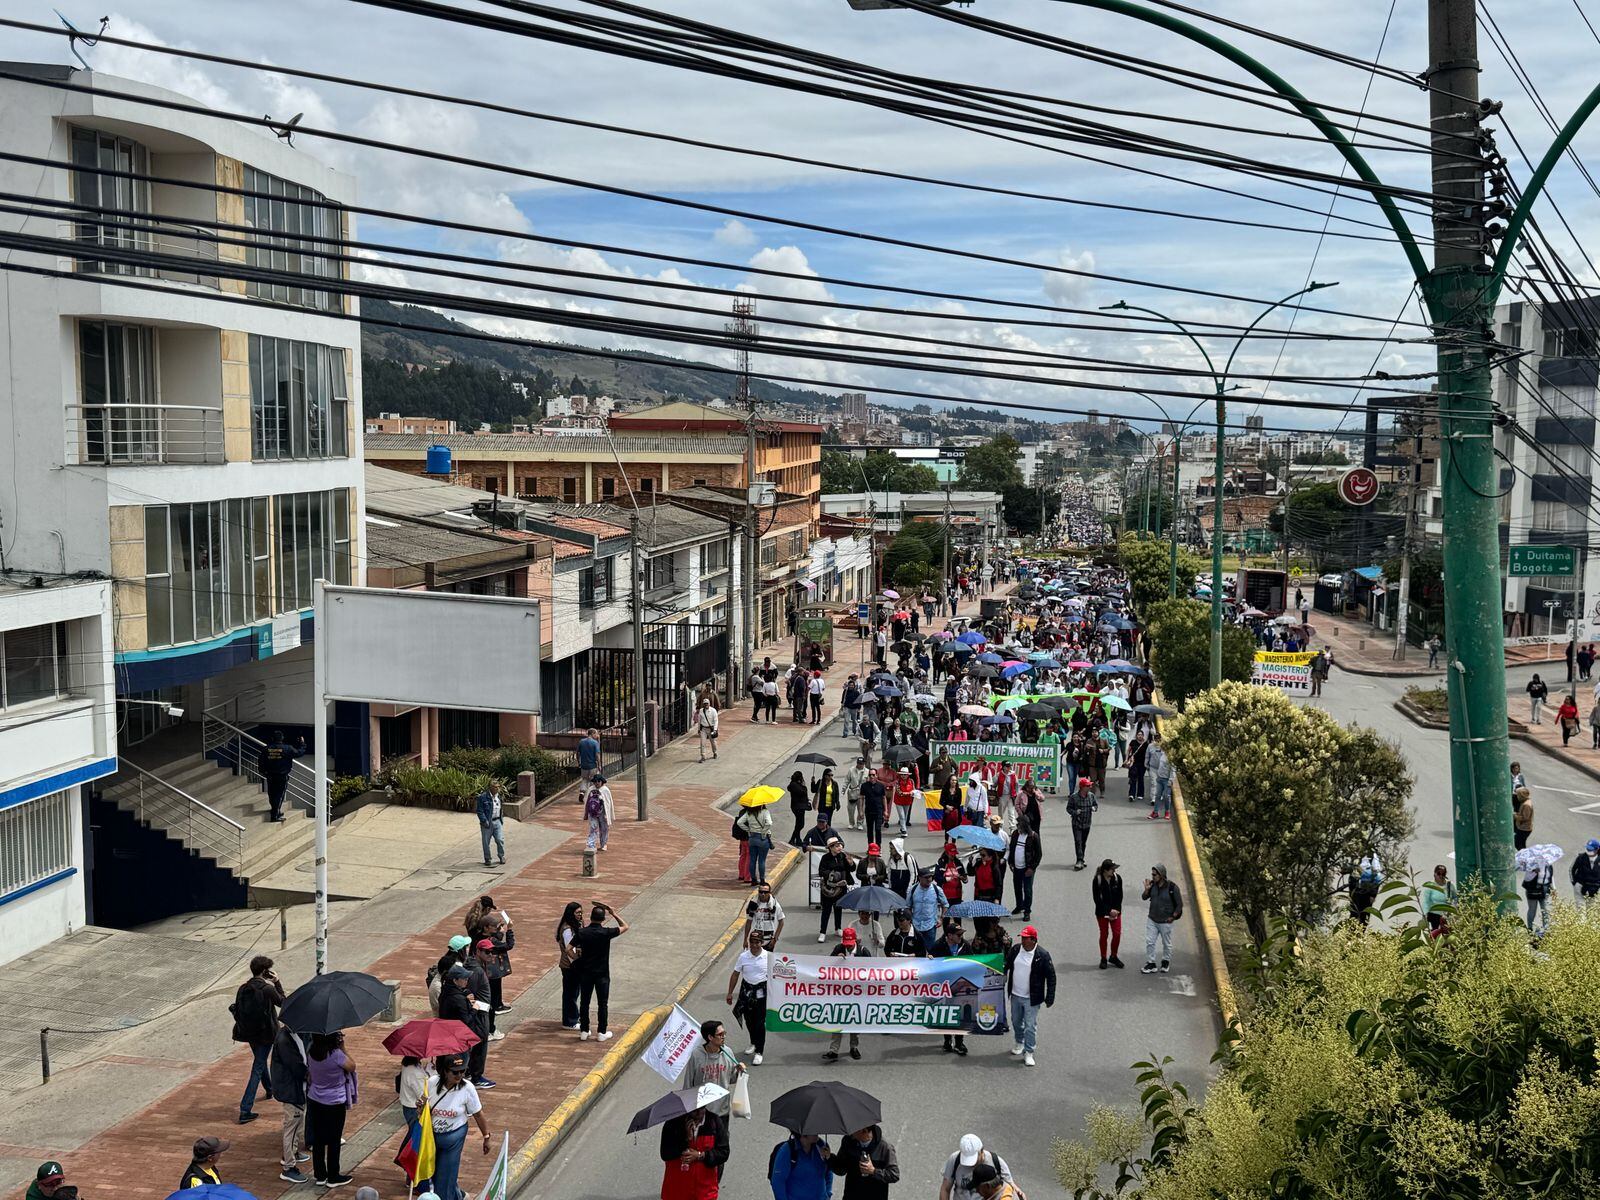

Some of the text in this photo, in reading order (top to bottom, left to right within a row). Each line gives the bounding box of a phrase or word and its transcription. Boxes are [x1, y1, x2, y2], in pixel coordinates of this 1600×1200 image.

[1527, 551, 1571, 560] Duitama
[1513, 562, 1553, 574] Bogotá
[1261, 664, 1309, 674] MAGISTERIO
[993, 745, 1006, 757] DE
[1007, 746, 1055, 758] MOTAVITA
[818, 967, 919, 981] SINDICATO DE
[785, 979, 953, 998] MAESTROS DE BOYACÁ
[778, 1003, 961, 1026] CUCAITA PRESENTE
